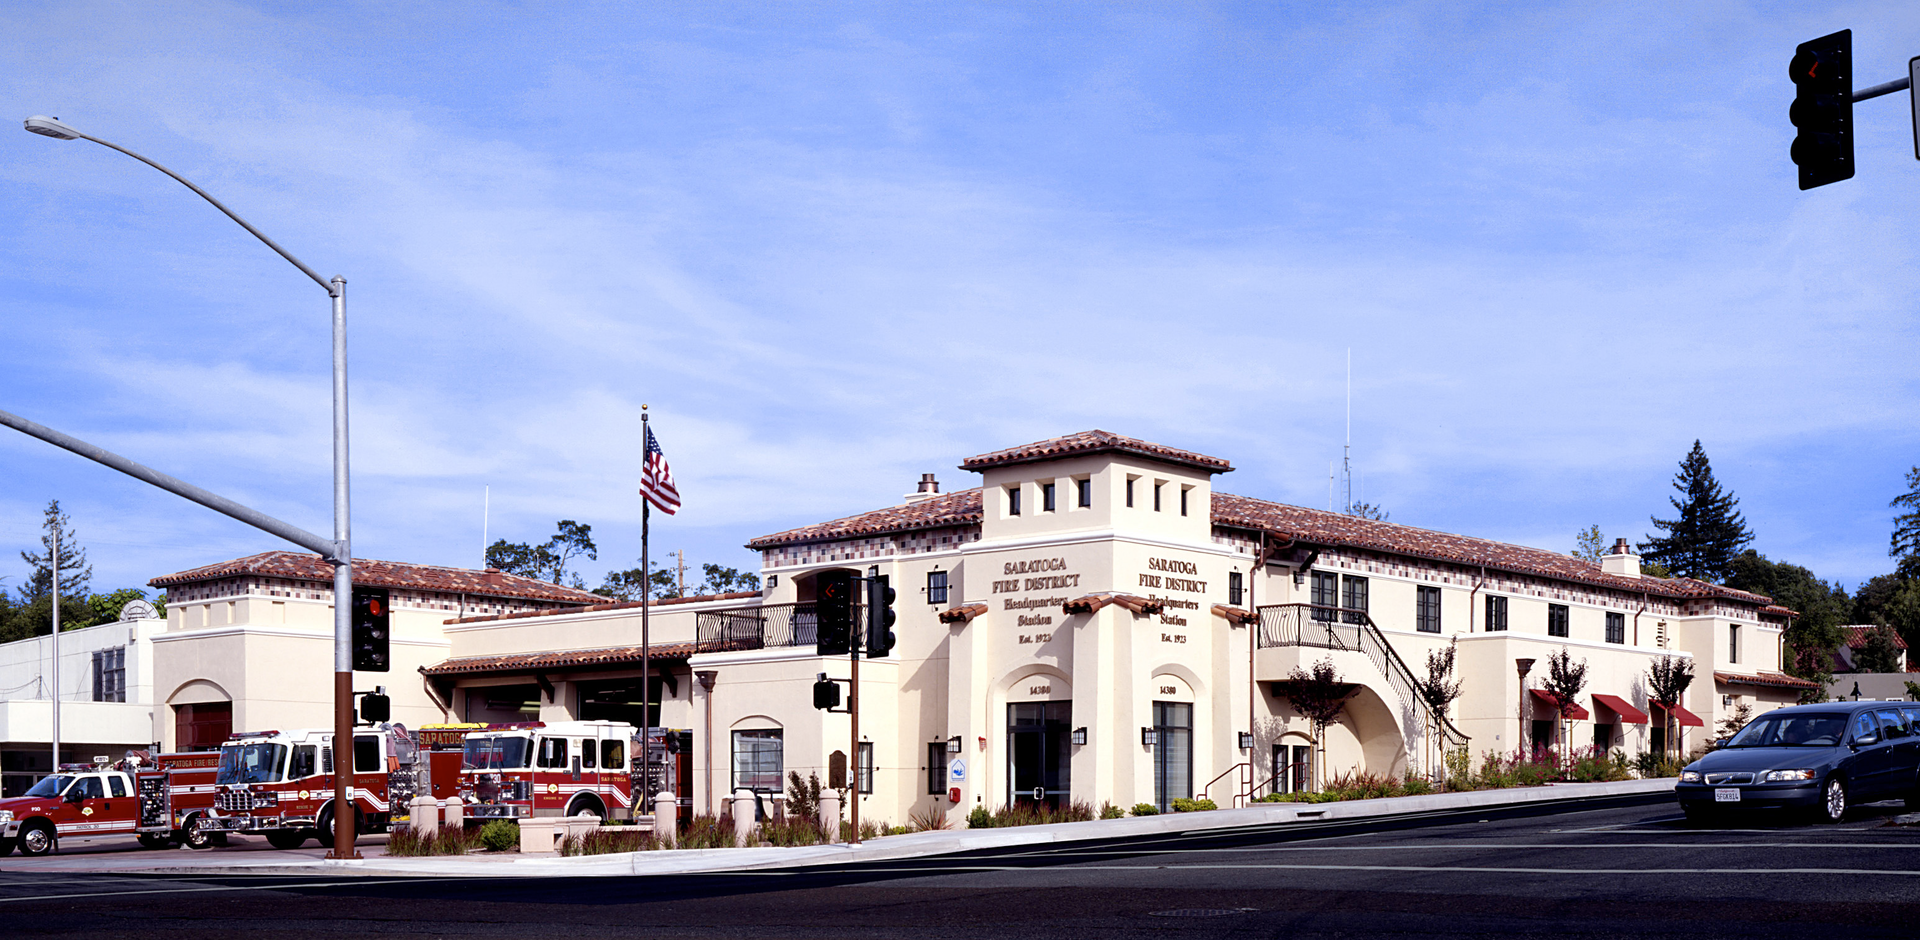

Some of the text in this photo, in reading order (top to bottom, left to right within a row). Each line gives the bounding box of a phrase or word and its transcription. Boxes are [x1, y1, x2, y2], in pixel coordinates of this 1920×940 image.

[1004, 557, 1067, 575] SARATOGA
[1148, 557, 1198, 575] SARATOGA
[992, 573, 1080, 594] FIRE DISTRICT
[1139, 573, 1207, 593] FIRE DISTRICT
[1004, 596, 1068, 611] Headquarters
[1017, 614, 1052, 627] Station
[1160, 613, 1187, 626] Station
[1018, 633, 1052, 644] Est. 1923
[1161, 633, 1187, 643] Est. 1923
[1030, 685, 1051, 695] 14380
[1160, 685, 1176, 695] 14380
[419, 733, 465, 744] SARATOGA
[194, 759, 219, 767] FIRE/RES
[474, 774, 479, 784] E
